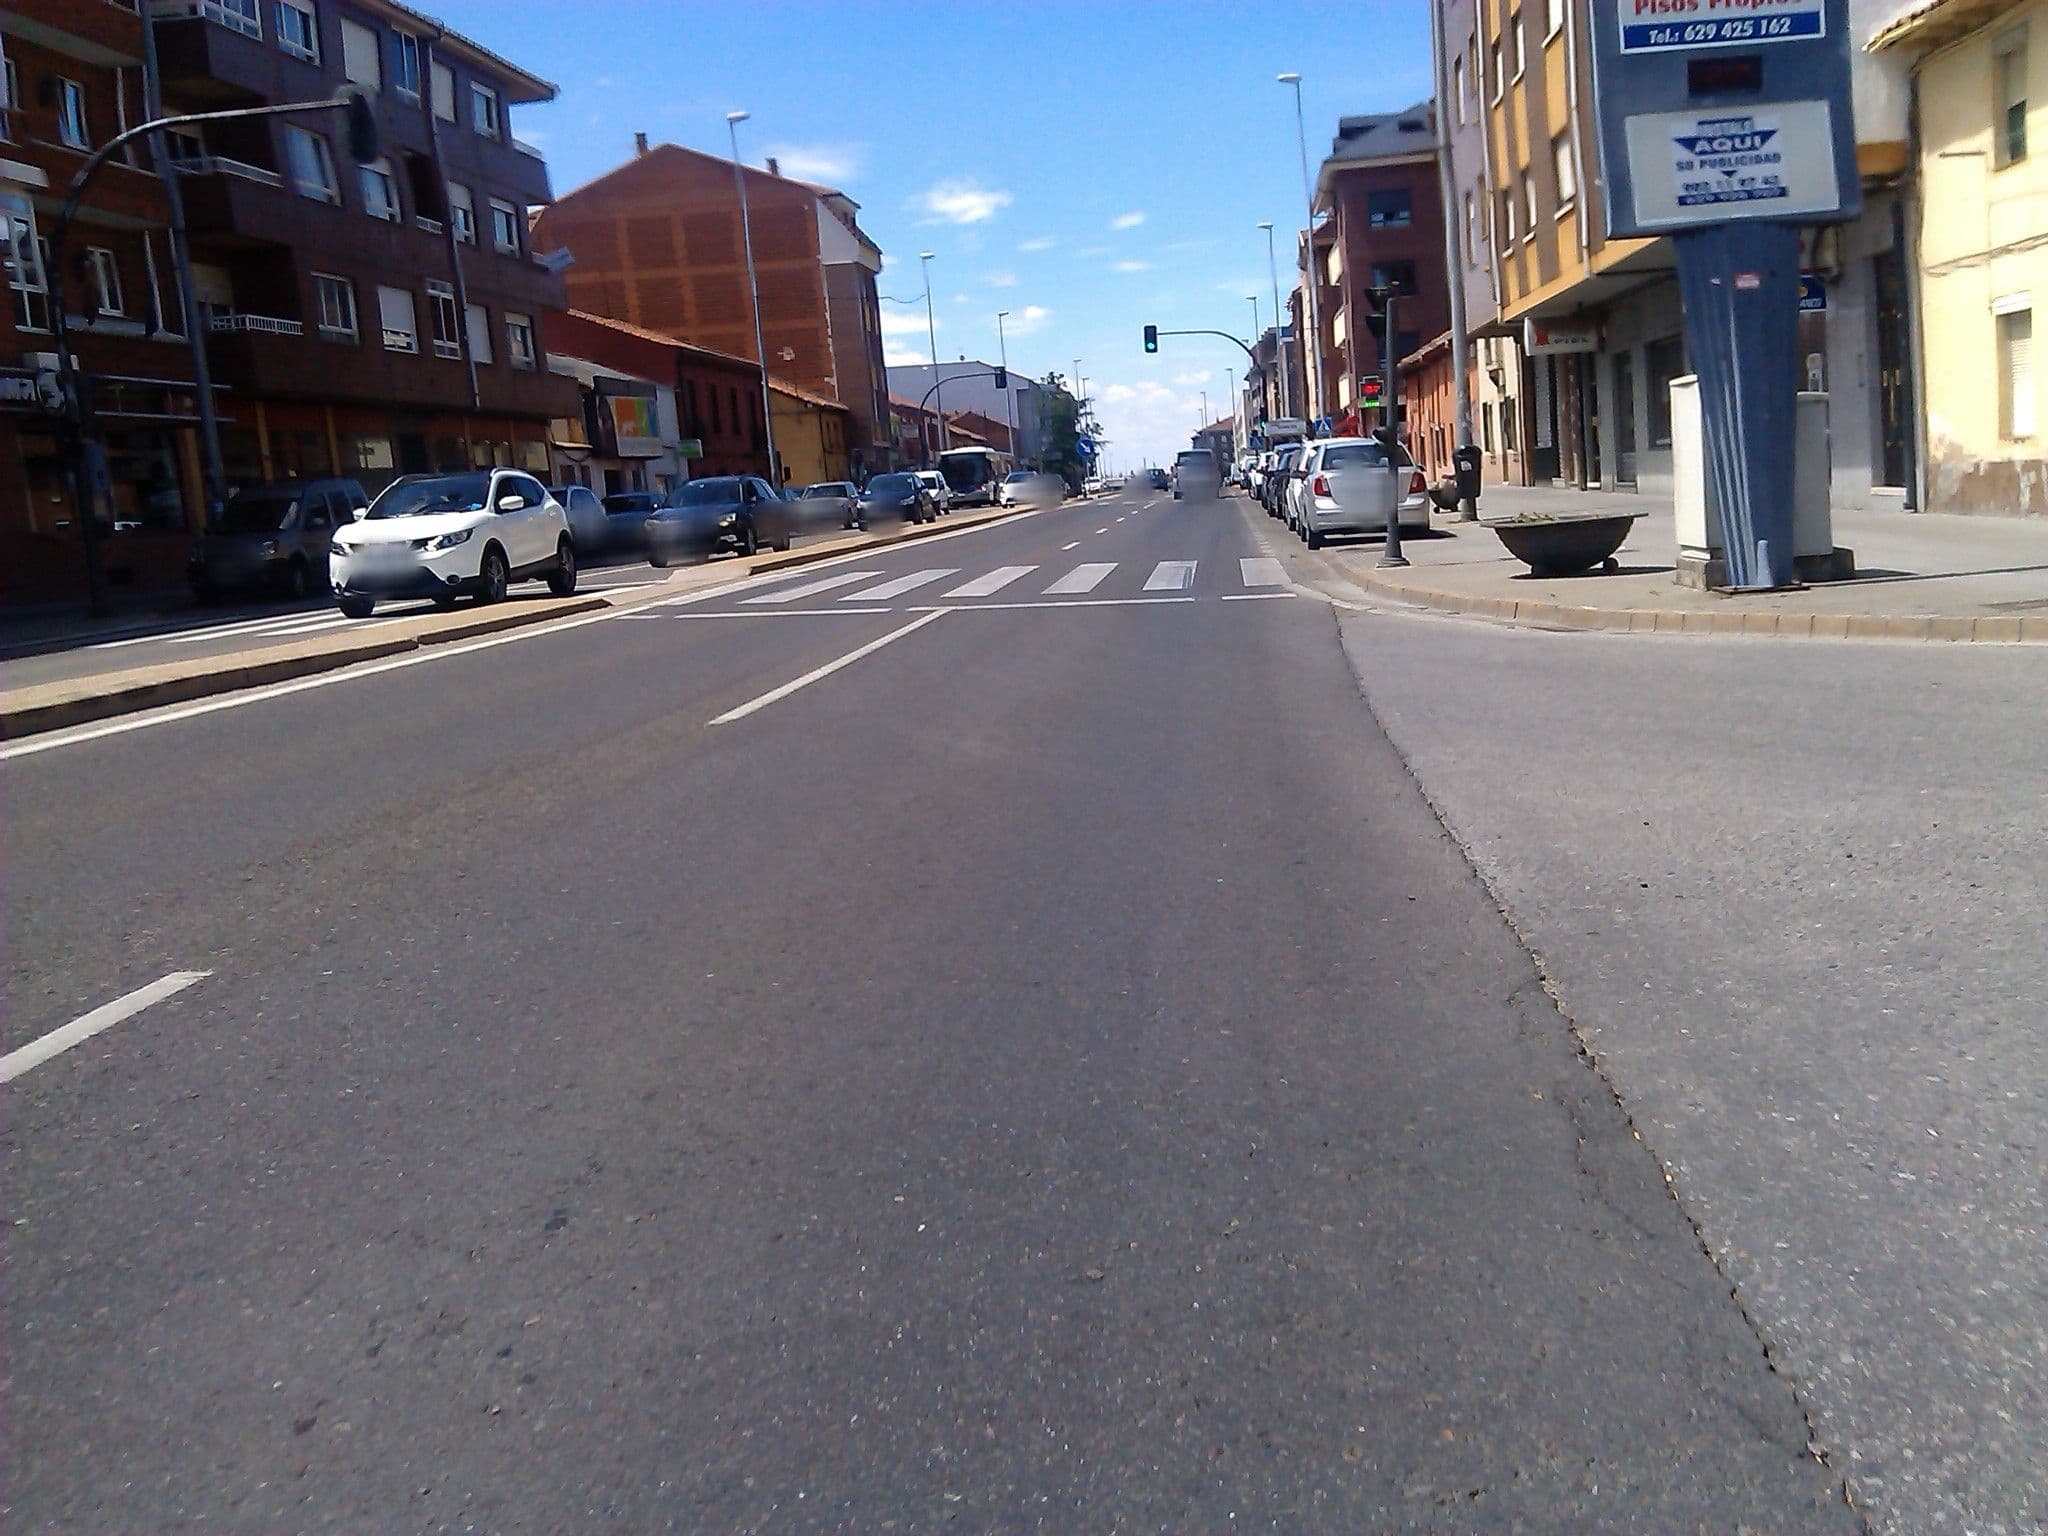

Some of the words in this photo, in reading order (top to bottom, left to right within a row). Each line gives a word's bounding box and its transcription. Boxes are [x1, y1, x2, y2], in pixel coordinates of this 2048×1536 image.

[1634, 0, 1699, 15] Pisos
[1708, 0, 1801, 9] Prop
[1684, 23, 1717, 41] 629
[1721, 19, 1754, 37] 425
[1760, 17, 1792, 34] 162
[1695, 135, 1761, 153] AQUI
